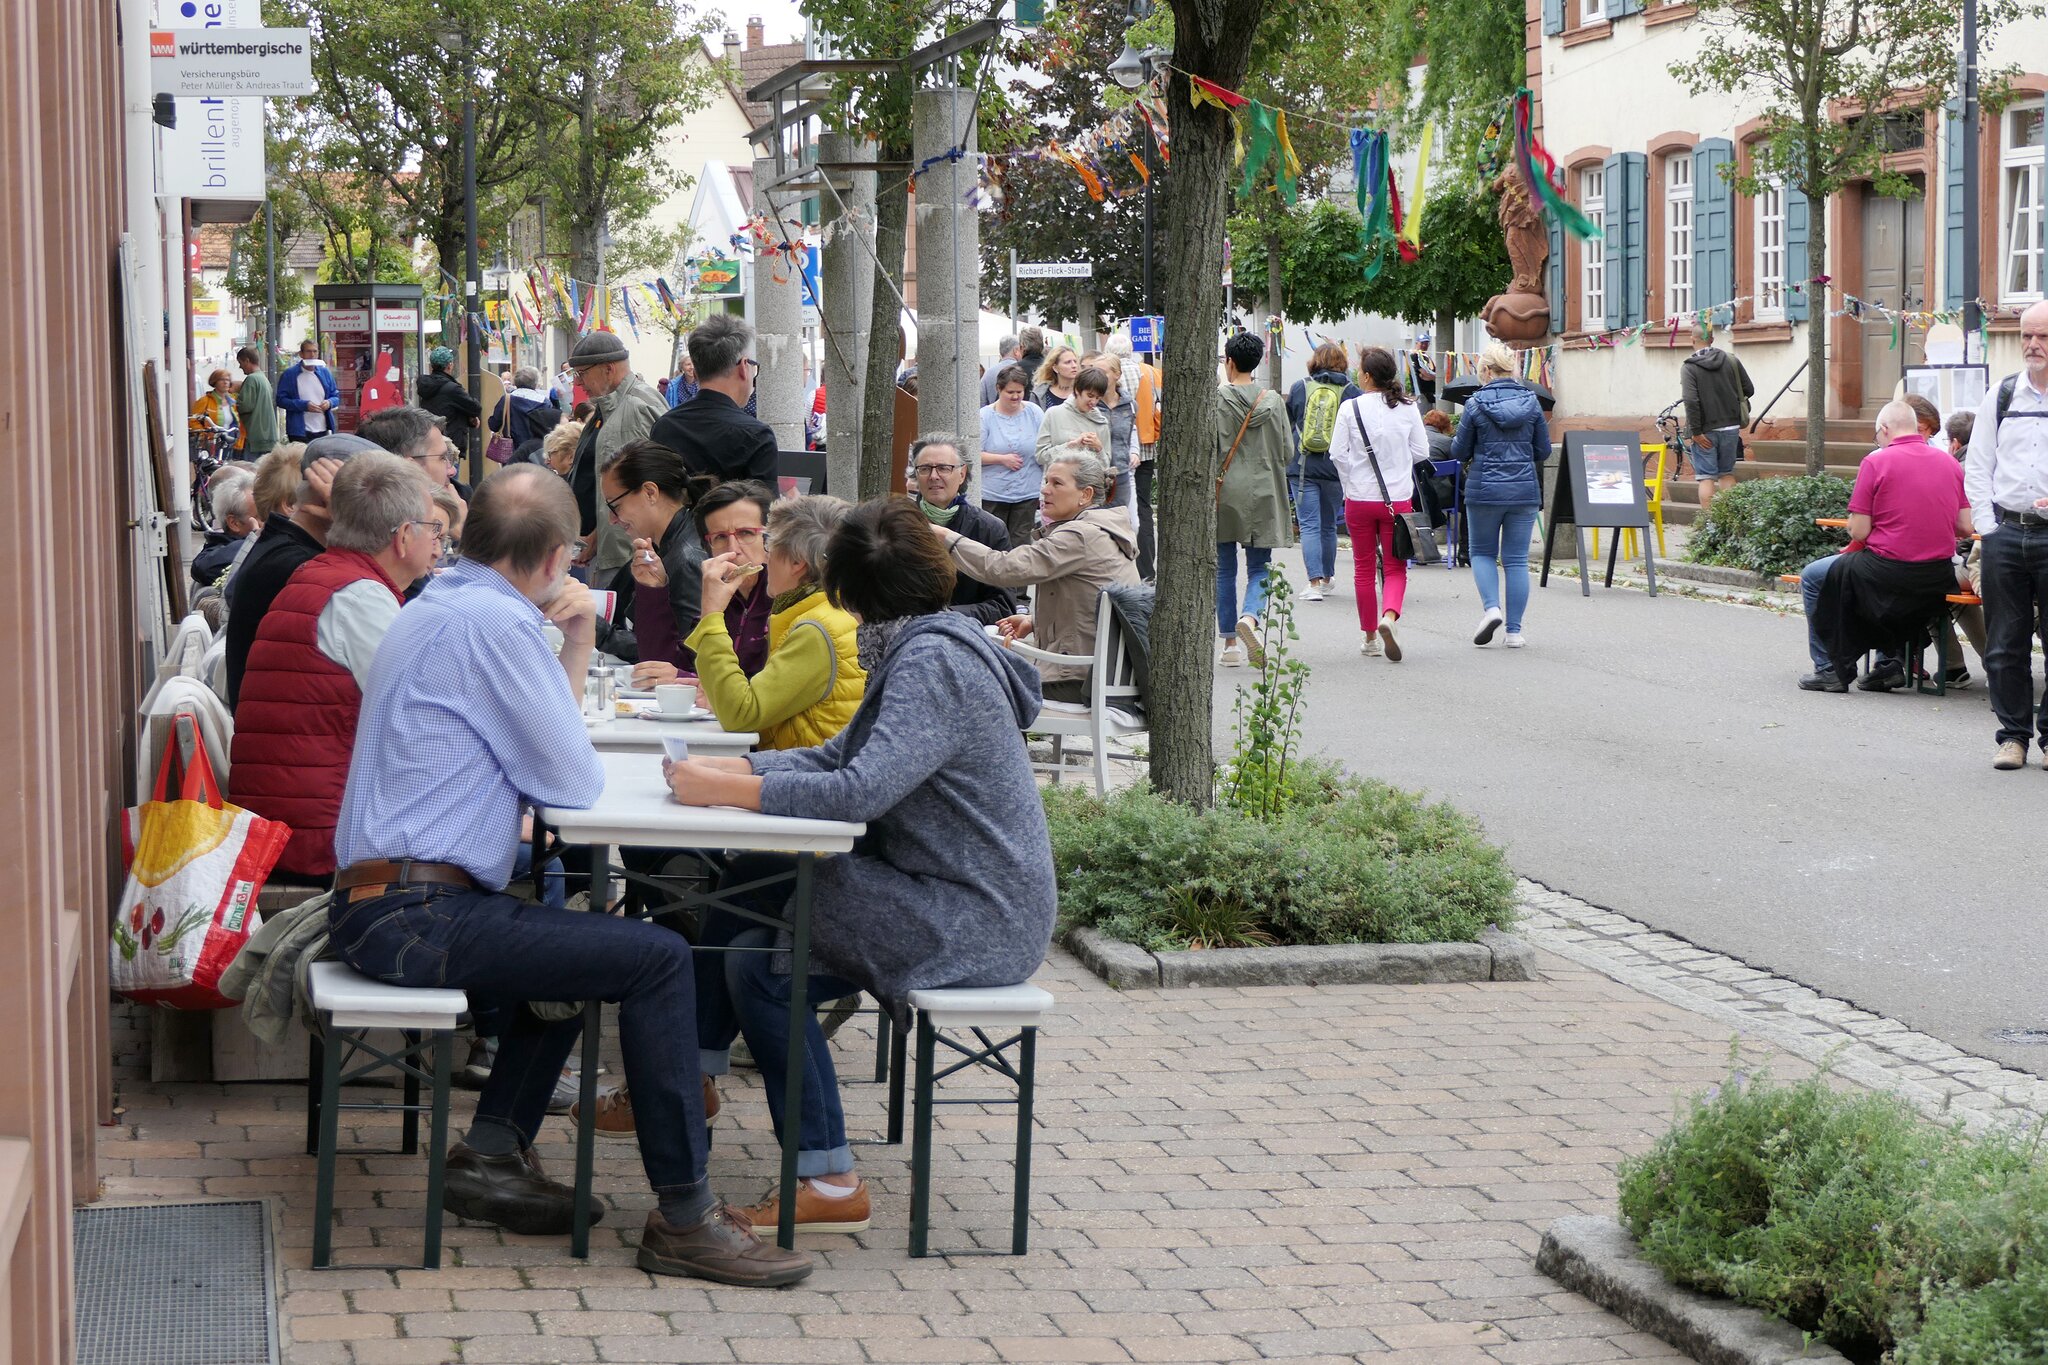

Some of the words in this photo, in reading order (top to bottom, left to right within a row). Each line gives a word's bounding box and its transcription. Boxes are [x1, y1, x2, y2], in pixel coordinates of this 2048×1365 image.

[179, 42, 302, 57] württembergische
[180, 70, 260, 80] Versicherungsbüro
[181, 82, 202, 90] Peter
[206, 81, 233, 90] Müller
[245, 81, 281, 90] Andreas
[283, 81, 304, 90] Traut
[231, 97, 242, 148] augenop
[1018, 266, 1089, 276] Richard-Flick-Straße
[702, 273, 729, 282] CAP
